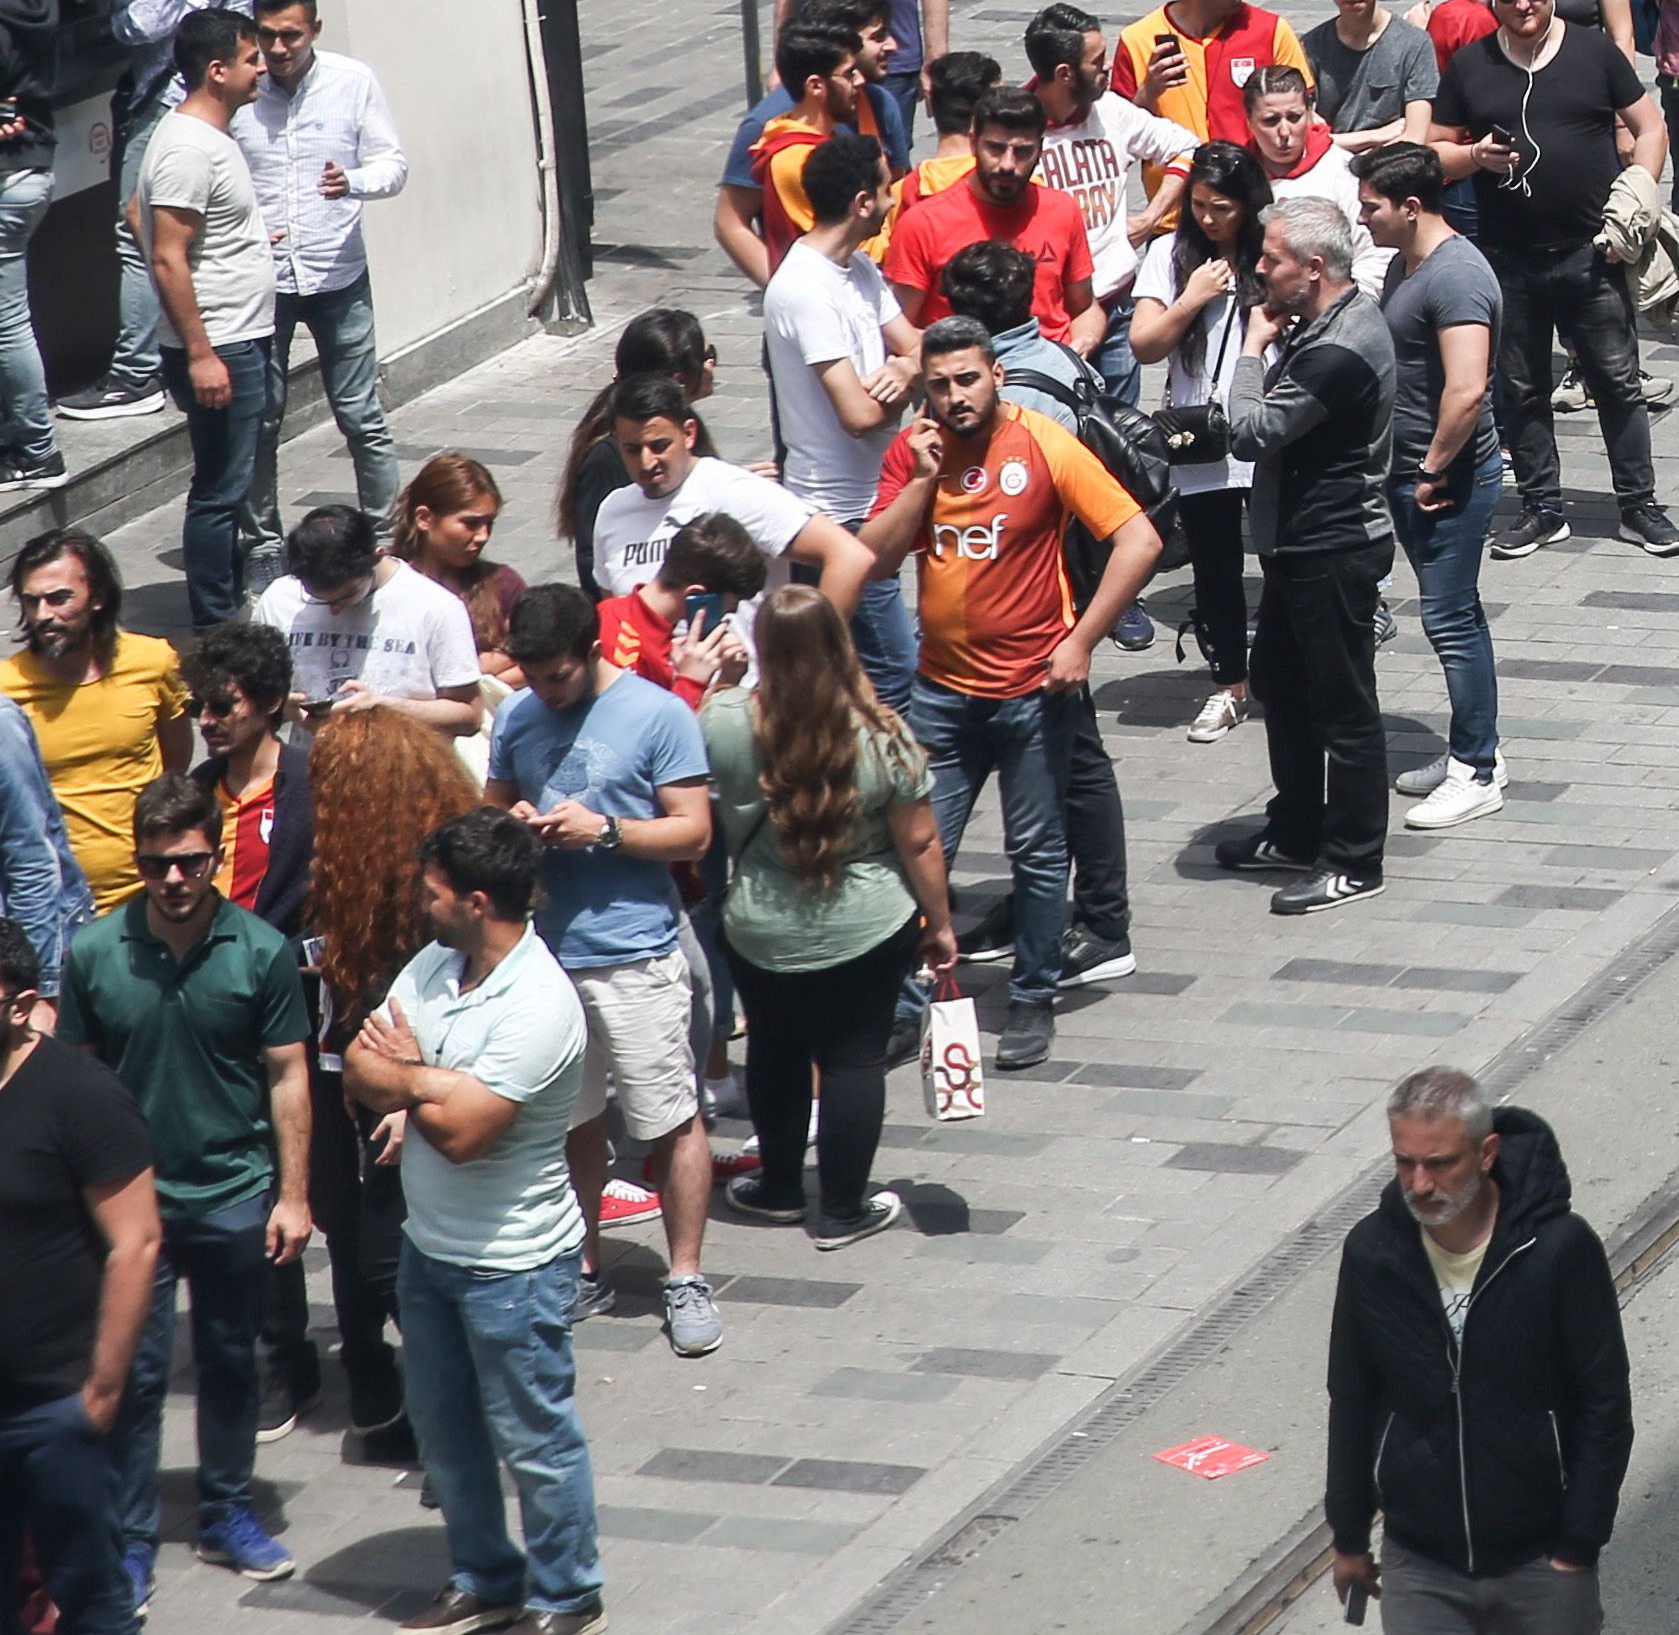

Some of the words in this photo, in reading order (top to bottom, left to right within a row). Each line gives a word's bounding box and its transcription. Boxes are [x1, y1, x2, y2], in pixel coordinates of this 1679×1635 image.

[1037, 139, 1119, 189] ALATA
[1073, 181, 1115, 230] RAY
[623, 538, 667, 567] PUM
[934, 514, 1008, 560] nef
[317, 632, 340, 647] BY
[344, 633, 378, 650] THE
[383, 638, 416, 655] SEA
